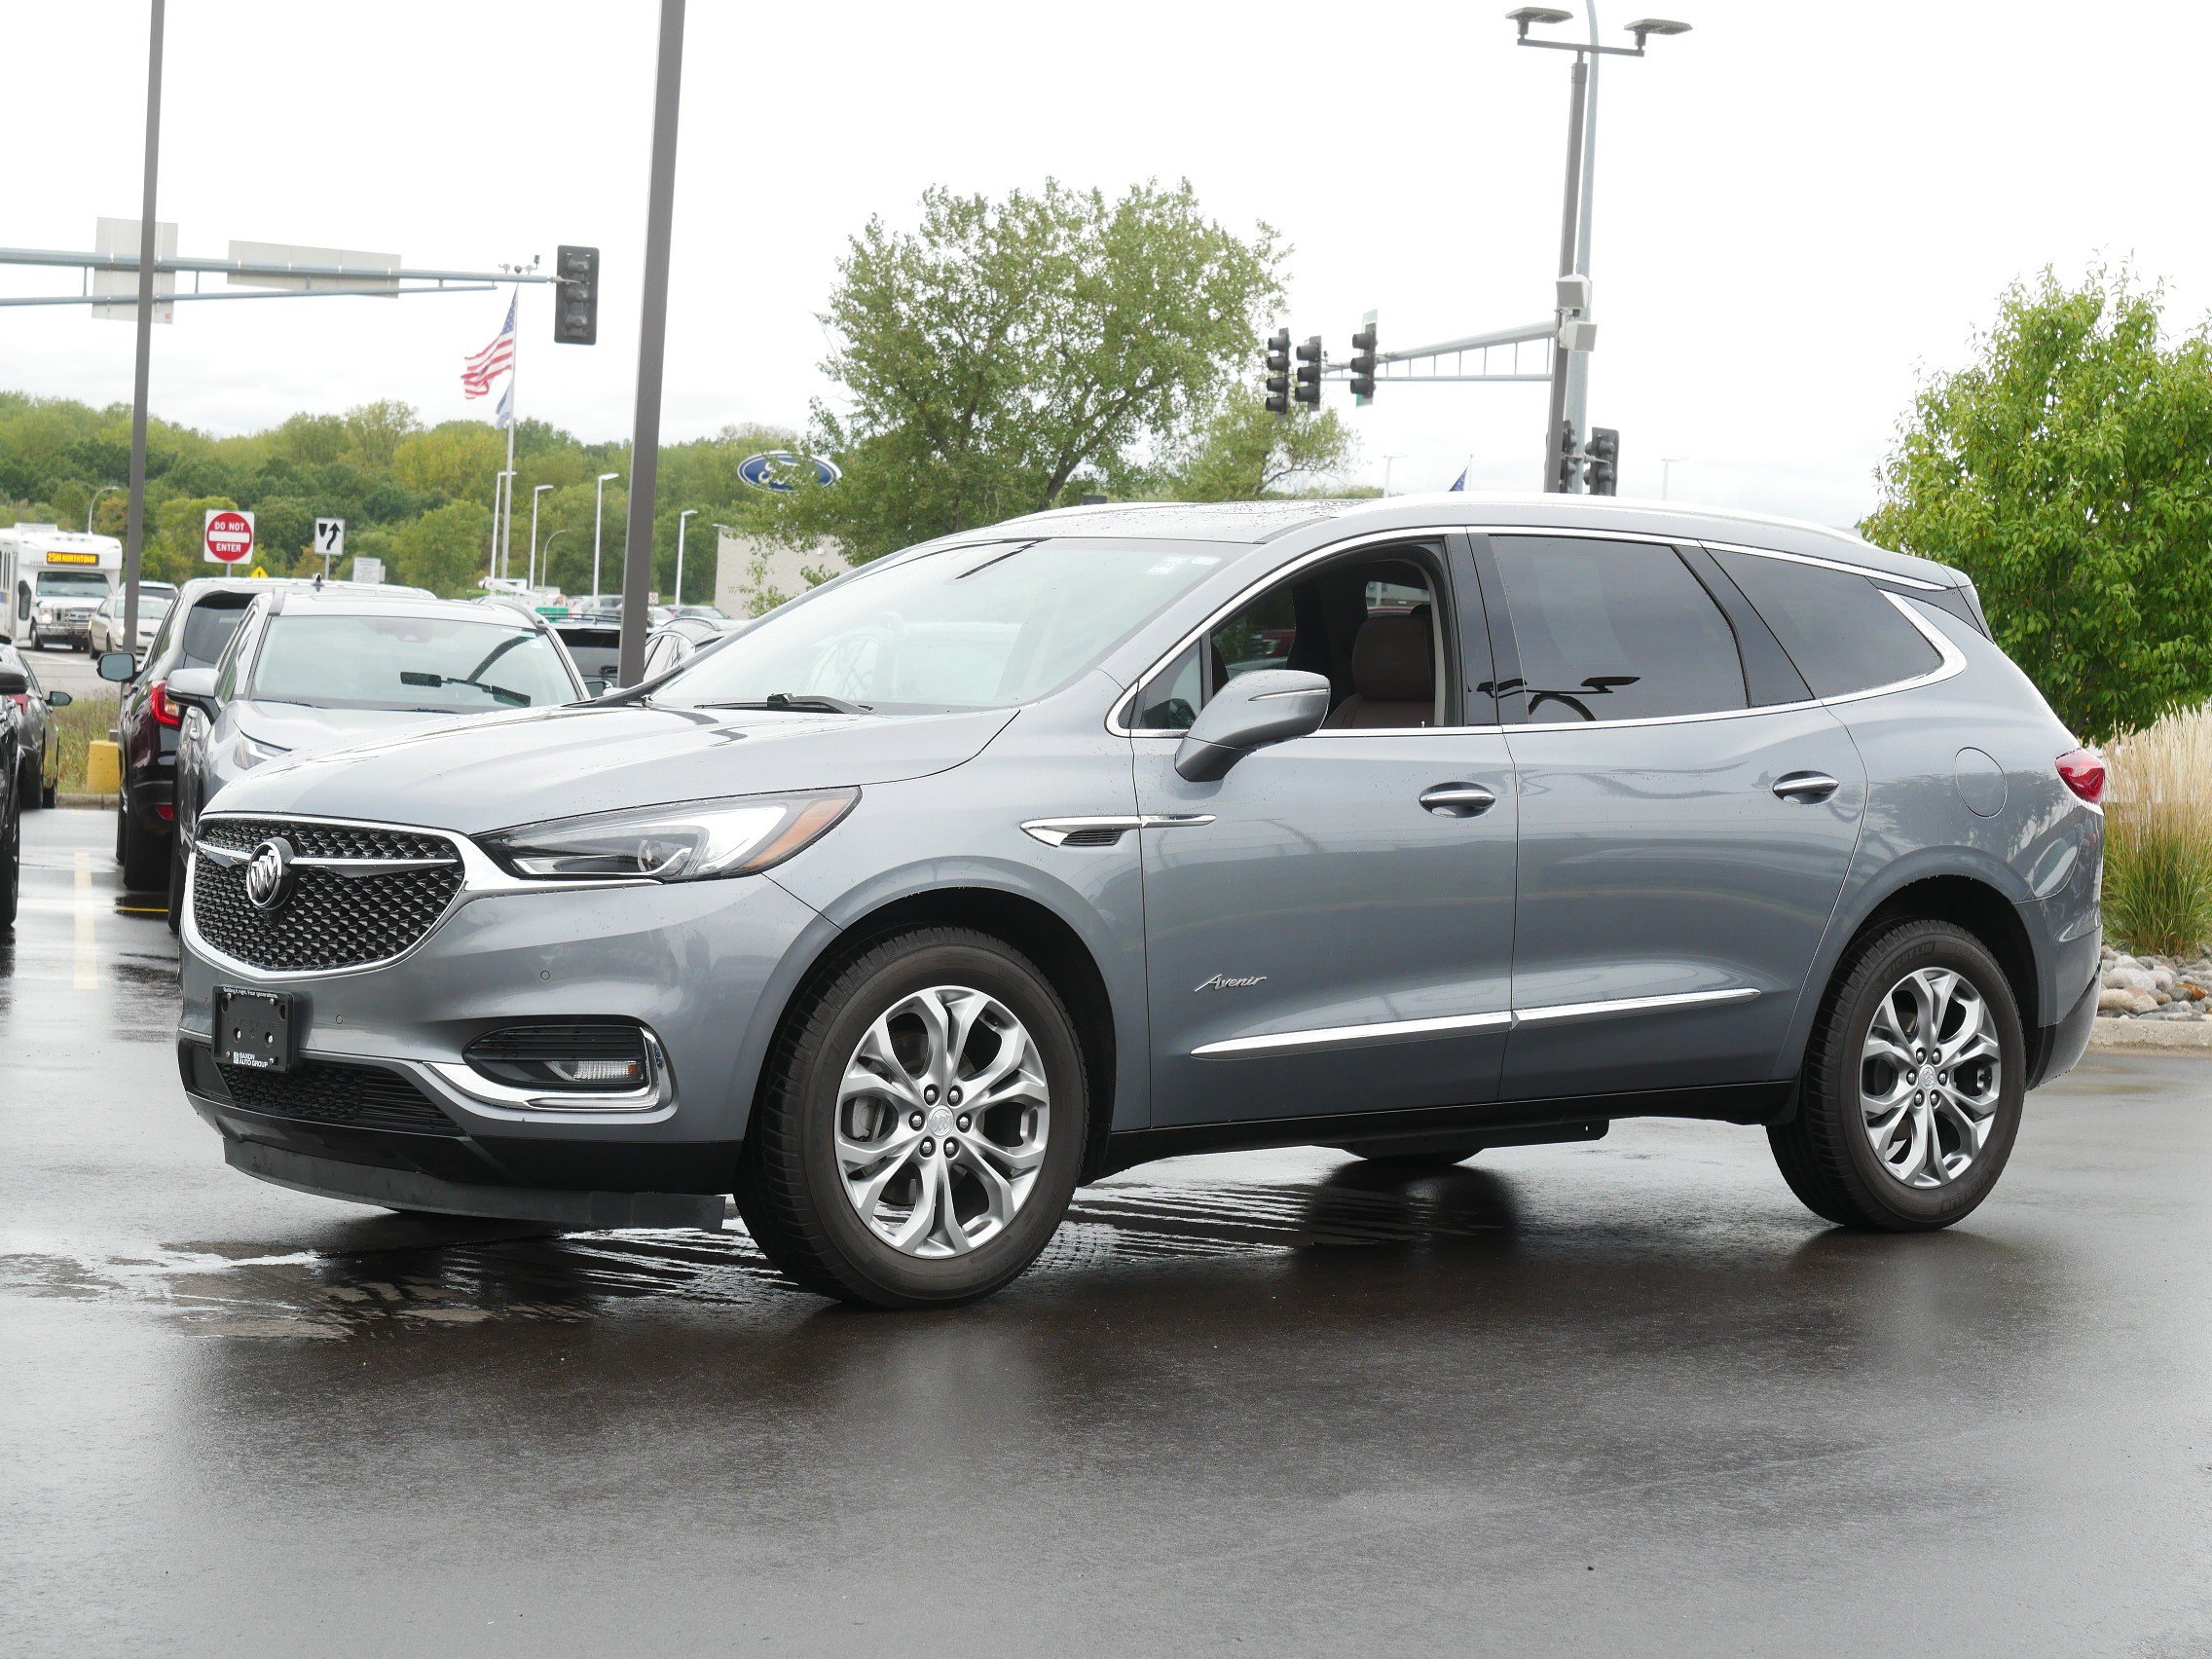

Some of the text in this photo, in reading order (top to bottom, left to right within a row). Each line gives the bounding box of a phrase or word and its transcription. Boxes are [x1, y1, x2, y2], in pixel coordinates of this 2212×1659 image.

[214, 521, 244, 532] DO NOT
[216, 542, 241, 553] ENTER
[62, 553, 96, 564] NORTHTOWN
[1194, 974, 1268, 992] Avenir
[251, 1059, 269, 1068] GROUP
